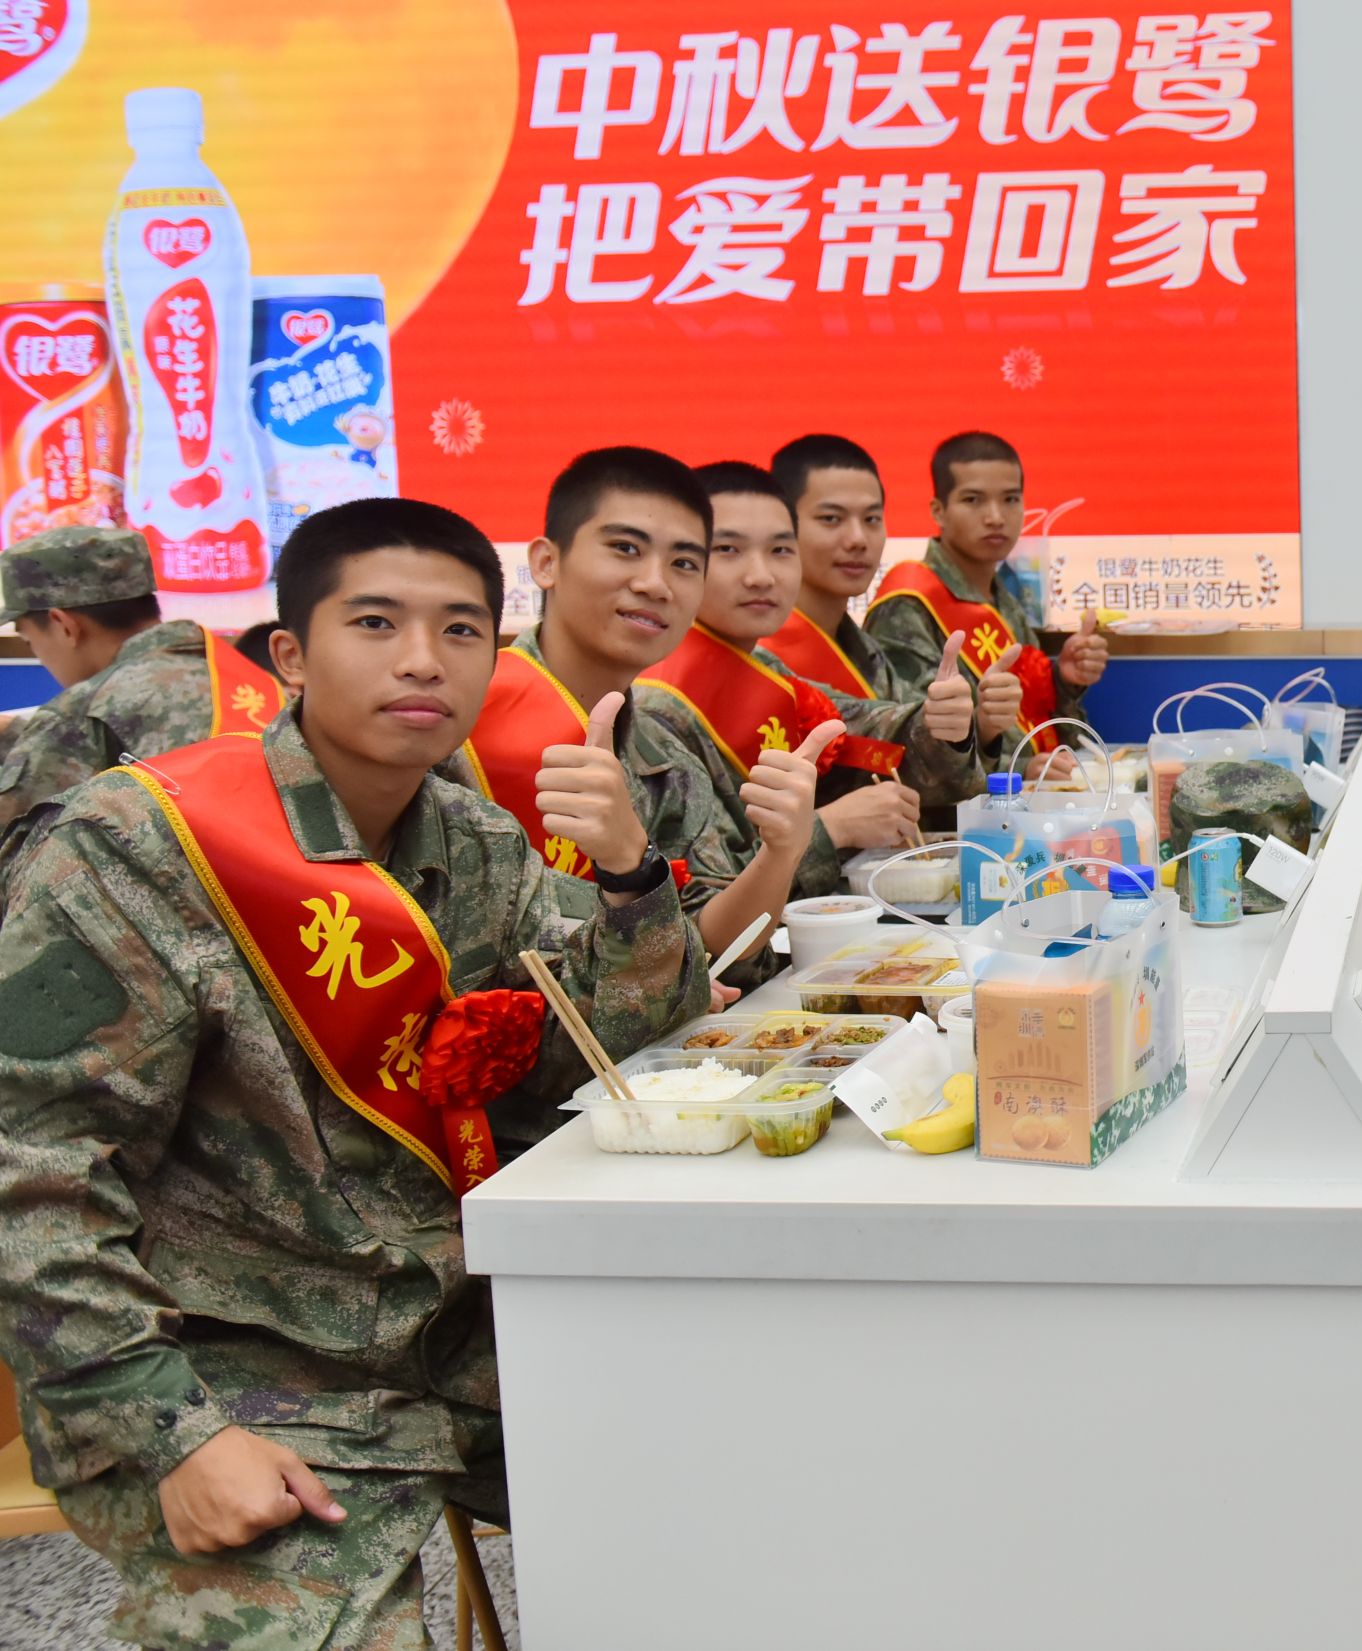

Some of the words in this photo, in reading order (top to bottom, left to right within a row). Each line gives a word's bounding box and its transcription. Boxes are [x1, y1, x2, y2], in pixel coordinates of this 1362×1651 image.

[529, 12, 1275, 160] 中秋送银鹭
[518, 165, 1267, 306] 把爱带回家
[13, 335, 97, 377] 银鹭
[166, 296, 207, 440] 花生牛奶
[1072, 581, 1254, 611] 全国销量领先
[1097, 557, 1226, 579] 银鹭牛奶花生
